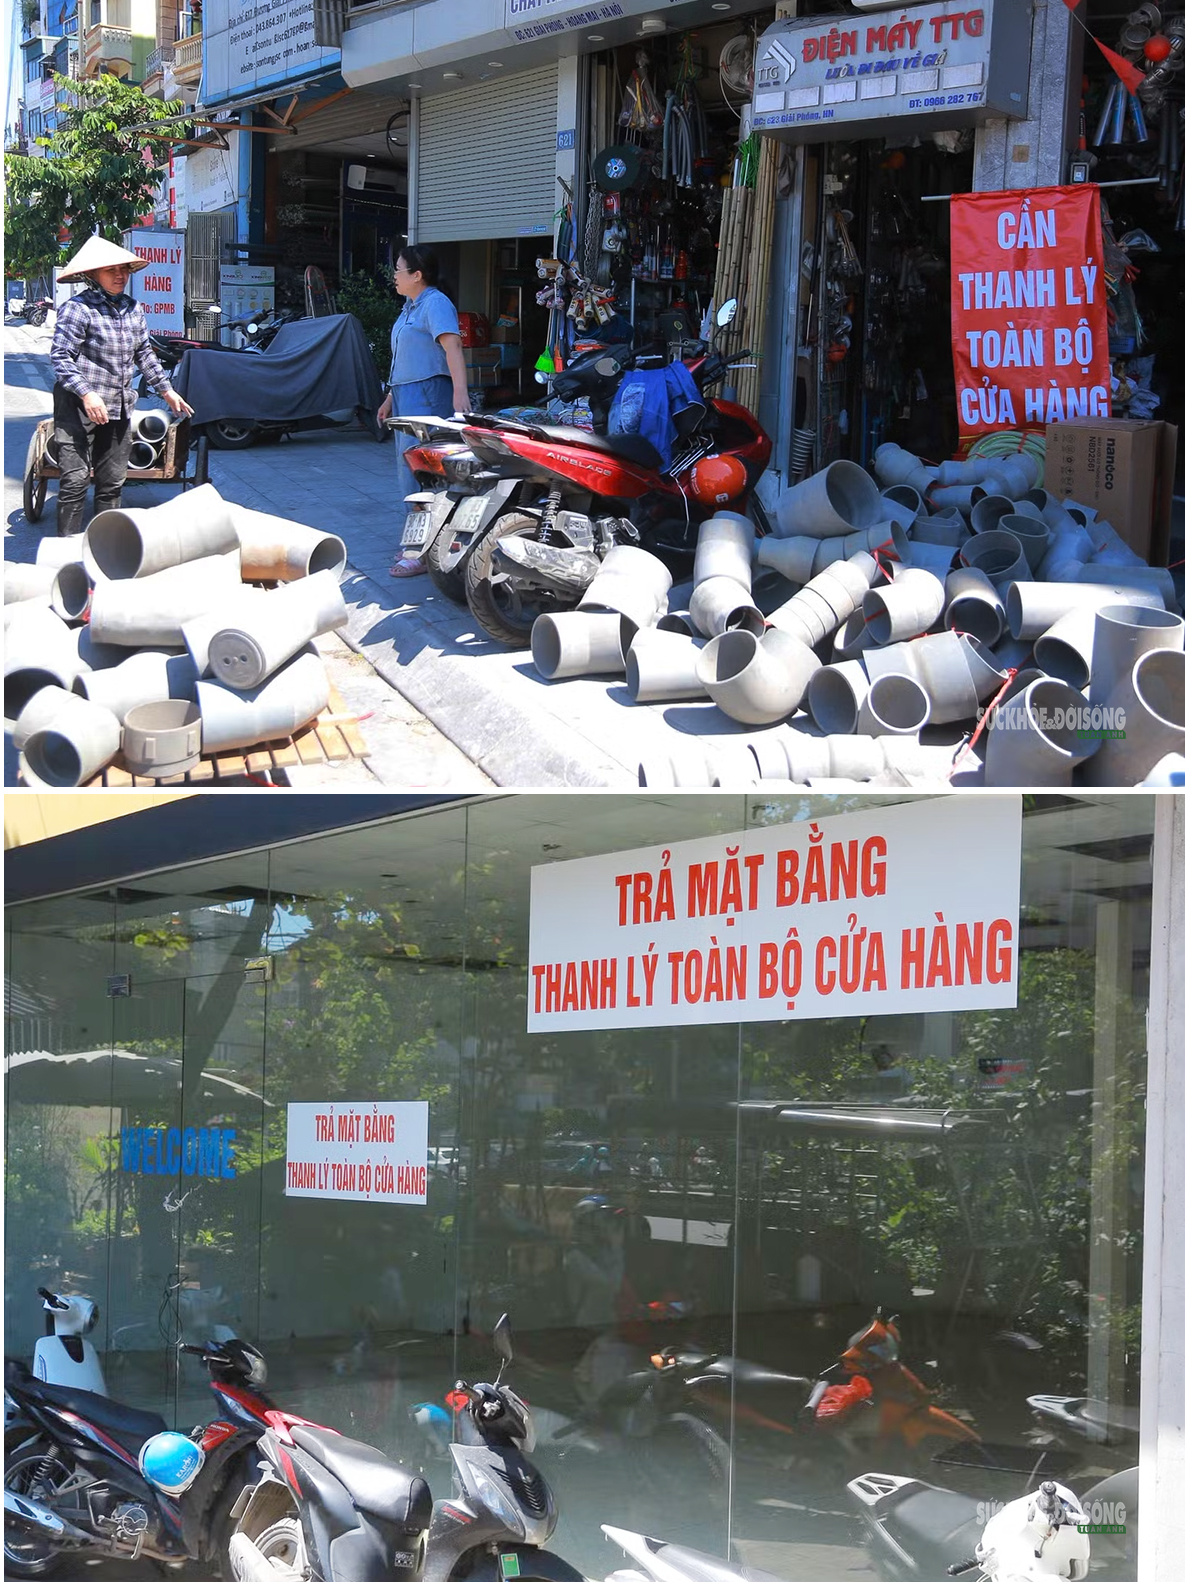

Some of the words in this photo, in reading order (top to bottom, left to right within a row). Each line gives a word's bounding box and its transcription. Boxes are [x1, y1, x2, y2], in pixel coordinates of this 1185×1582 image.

[525, 27, 534, 38] 621
[586, 10, 599, 22] MAI
[802, 27, 858, 64] ĐIỆN
[866, 15, 924, 53] MÁY
[929, 9, 985, 43] TTG
[758, 65, 779, 81] TTG
[822, 110, 834, 118] HN
[558, 134, 572, 147] 621
[997, 198, 1056, 250] CẦN
[134, 246, 168, 264] THANH
[170, 246, 182, 264] LÝ
[144, 273, 172, 292] HÀNG
[958, 267, 1056, 311] THANH
[1065, 257, 1098, 306] LÝ
[154, 303, 175, 315] GPMB
[966, 321, 1046, 369] TOÀN
[1054, 319, 1094, 374] BỘ
[960, 375, 1016, 427] CỬA
[1026, 377, 1109, 424] HÀNG
[546, 452, 612, 477] AIRBLADE
[1104, 437, 1116, 491] nanoco
[615, 850, 675, 927] TRẢ
[687, 845, 764, 927] MẶT
[776, 823, 888, 908] BẰNG
[532, 957, 617, 1014] THANH
[626, 943, 659, 1008] LÝ
[667, 937, 747, 1005] TOÀN
[758, 927, 802, 1011] BỘ
[814, 913, 888, 995] CỬA
[902, 911, 1013, 990] HÀNG
[315, 1105, 336, 1143] TRẢ
[337, 1106, 361, 1149] MẶT
[363, 1103, 395, 1144] BẰNG
[121, 1126, 237, 1180] WELCOME
[287, 1161, 316, 1189] THANH
[318, 1157, 331, 1191] LÝ
[331, 1158, 356, 1193] TOÀN
[358, 1158, 372, 1199] BỘ
[373, 1155, 395, 1195] CỬA
[397, 1158, 427, 1196] HÀNG
[210, 1424, 230, 1433] HONDA
